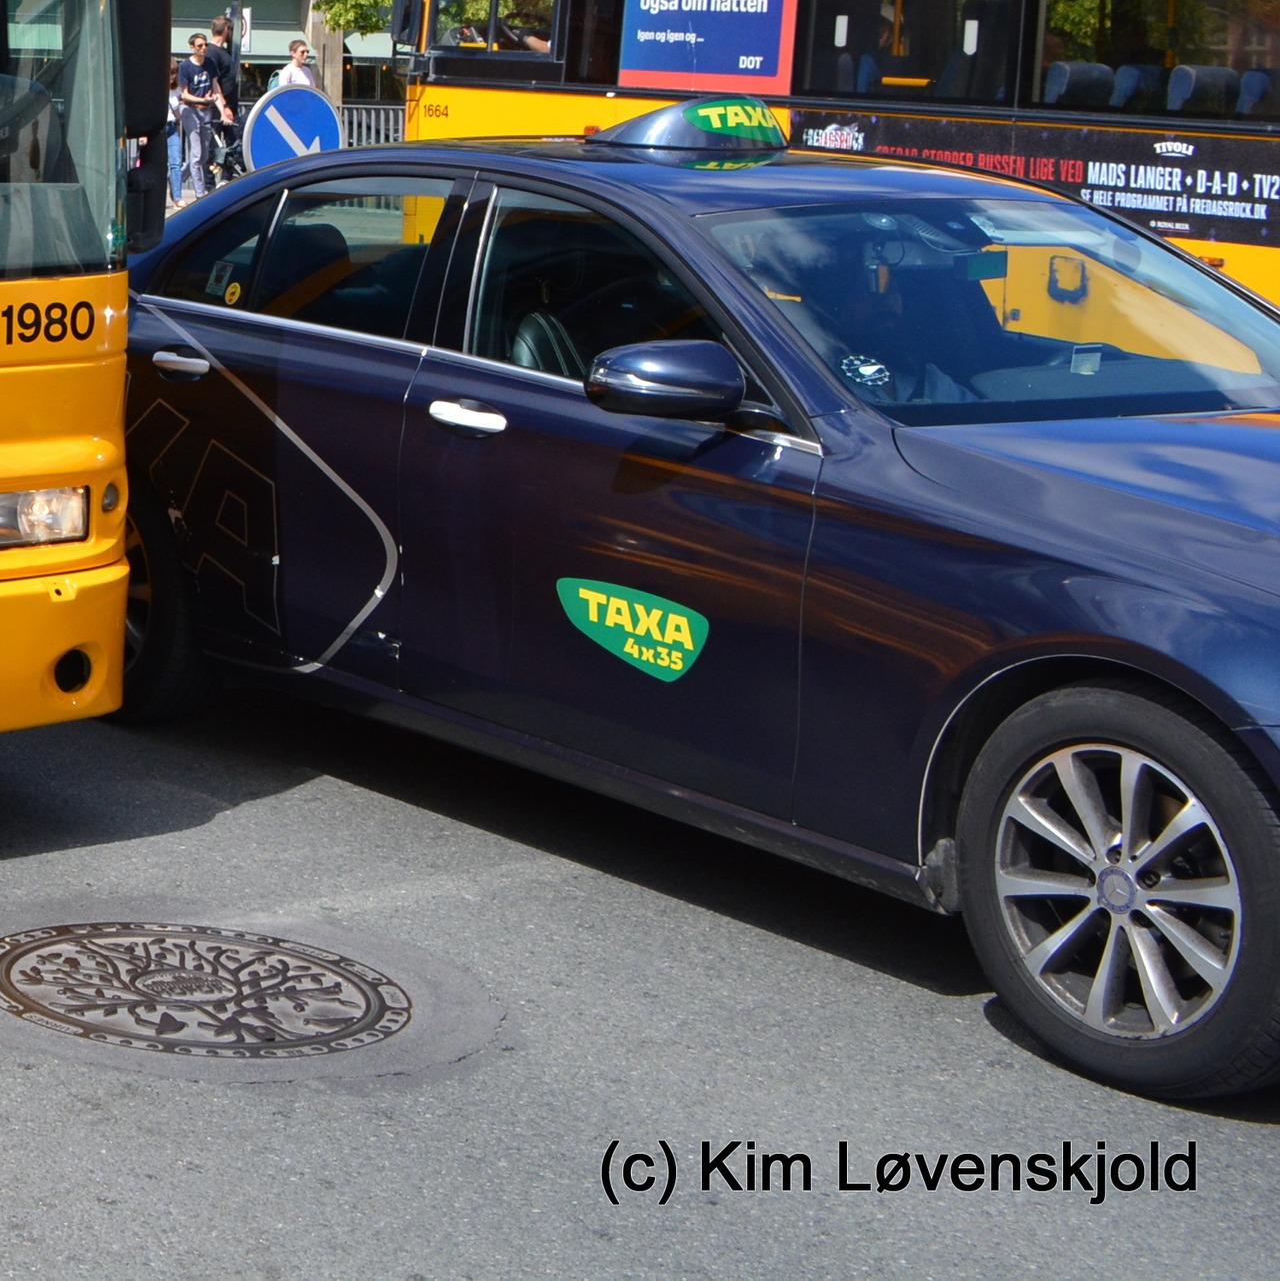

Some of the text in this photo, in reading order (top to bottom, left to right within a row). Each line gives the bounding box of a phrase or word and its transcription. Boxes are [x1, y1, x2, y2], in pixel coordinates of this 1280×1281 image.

[655, 31, 666, 43] og
[667, 29, 684, 43] igen
[739, 56, 763, 69] DOT
[423, 104, 449, 118] 1664
[1153, 142, 1194, 156] TIVOLI
[977, 153, 1025, 177] BUSSEN
[1029, 157, 1056, 181] LIGE
[1059, 159, 1083, 182] VED
[1087, 161, 1126, 187] MADS
[1130, 164, 1182, 191] LANGER
[1196, 170, 1238, 196] D-A-D
[1093, 190, 1113, 206] HELE
[1114, 192, 1174, 212] PROGRAMMET
[1176, 194, 1188, 213] PÅ
[1190, 198, 1267, 219] FREDAGSROCK.DK
[1, 300, 95, 345] 1980
[578, 587, 695, 651] TAXA
[623, 637, 684, 671] 4x35
